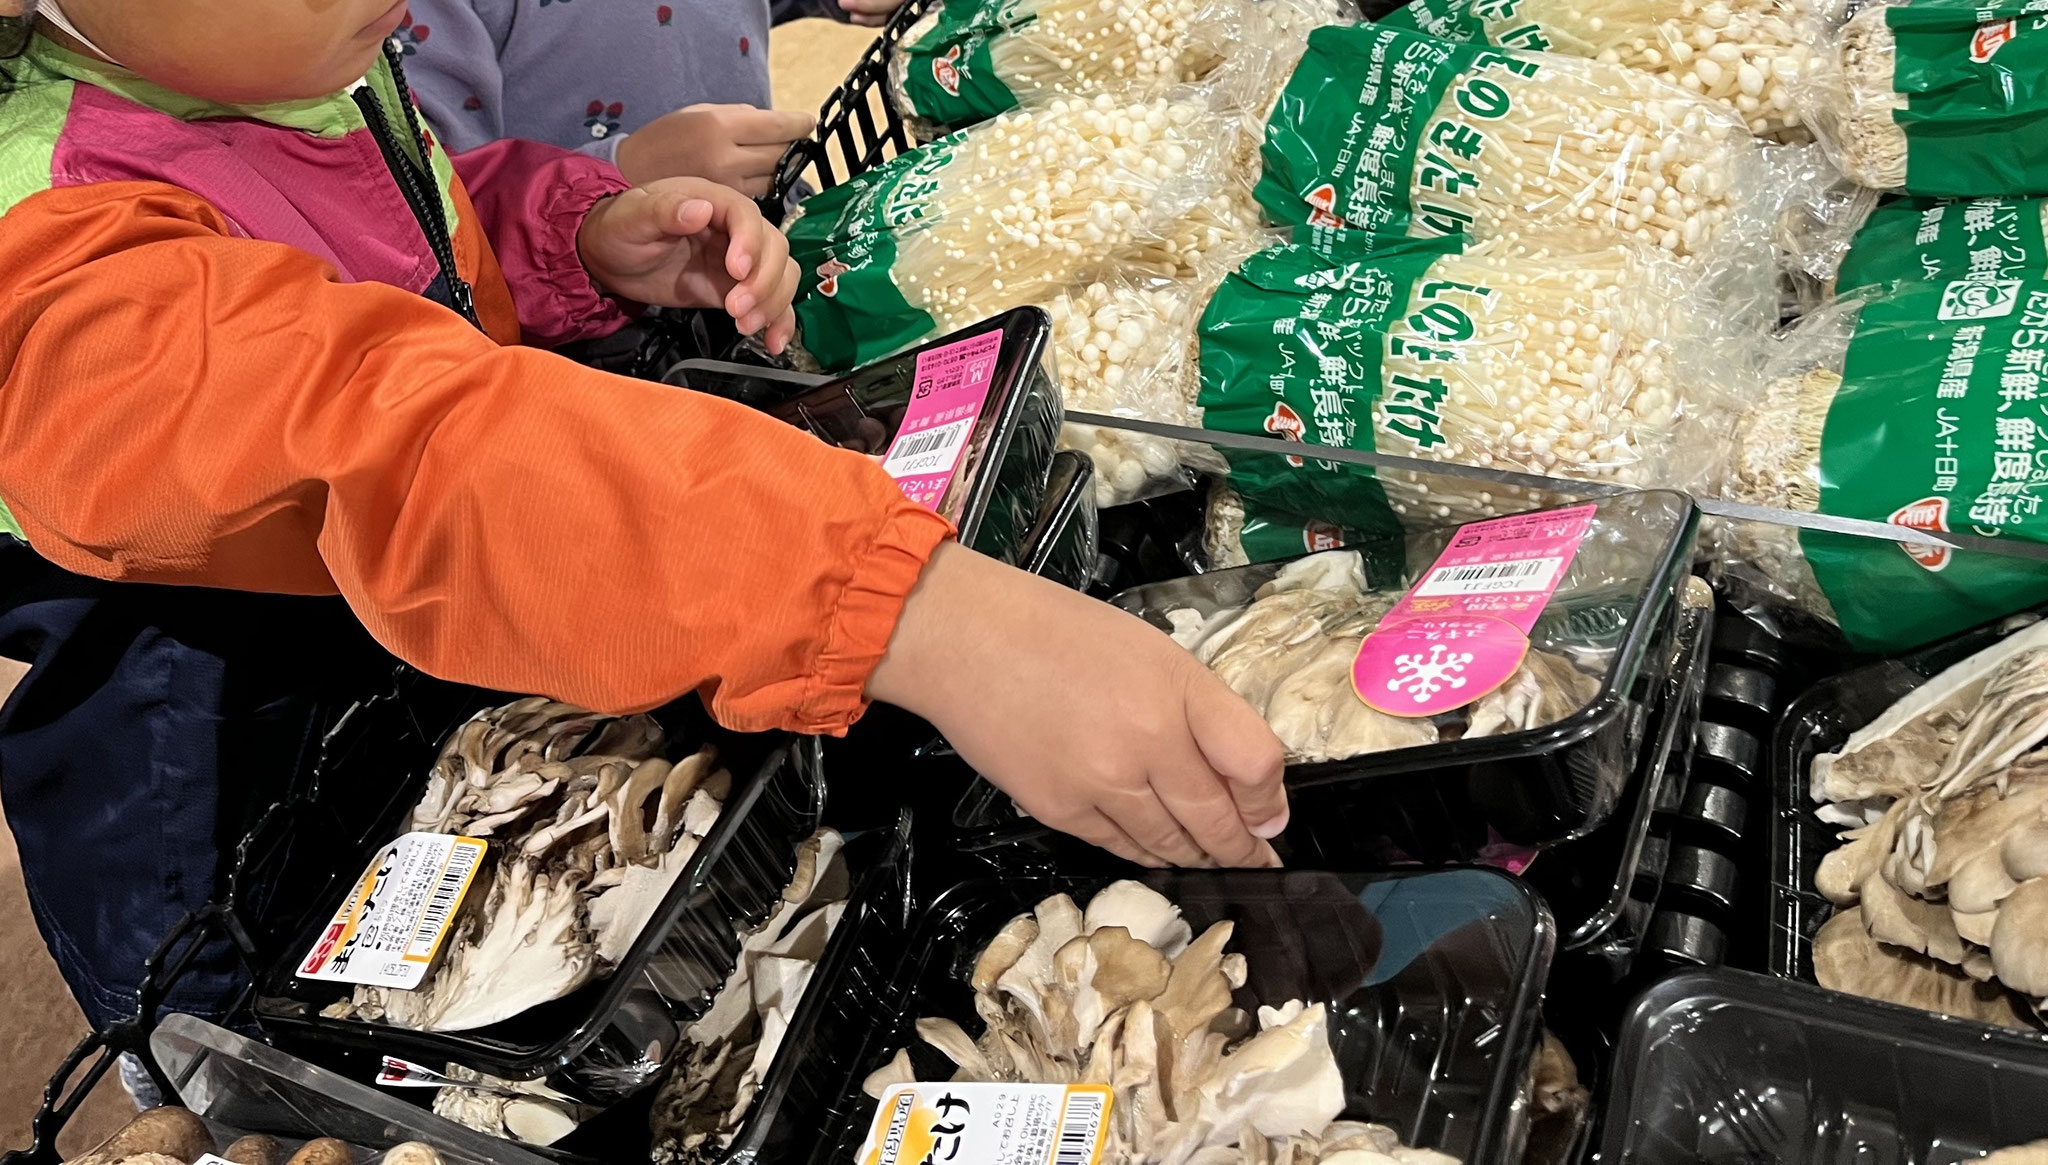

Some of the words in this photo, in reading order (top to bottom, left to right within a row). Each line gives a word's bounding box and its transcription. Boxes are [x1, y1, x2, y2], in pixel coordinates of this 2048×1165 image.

[1331, 110, 1366, 178] JA十日町
[1345, 40, 1432, 229] ら新鮮、鮮度長持
[1920, 253, 1941, 280] JA
[1996, 205, 2027, 284] パックし
[1936, 324, 1986, 400] 新潟県産
[1931, 406, 1961, 492] JA十日町
[331, 847, 398, 975] まいたけ
[992, 1094, 1007, 1128] A029
[1020, 1094, 1037, 1139] Olympic
[1082, 1102, 1102, 1156] 950678
